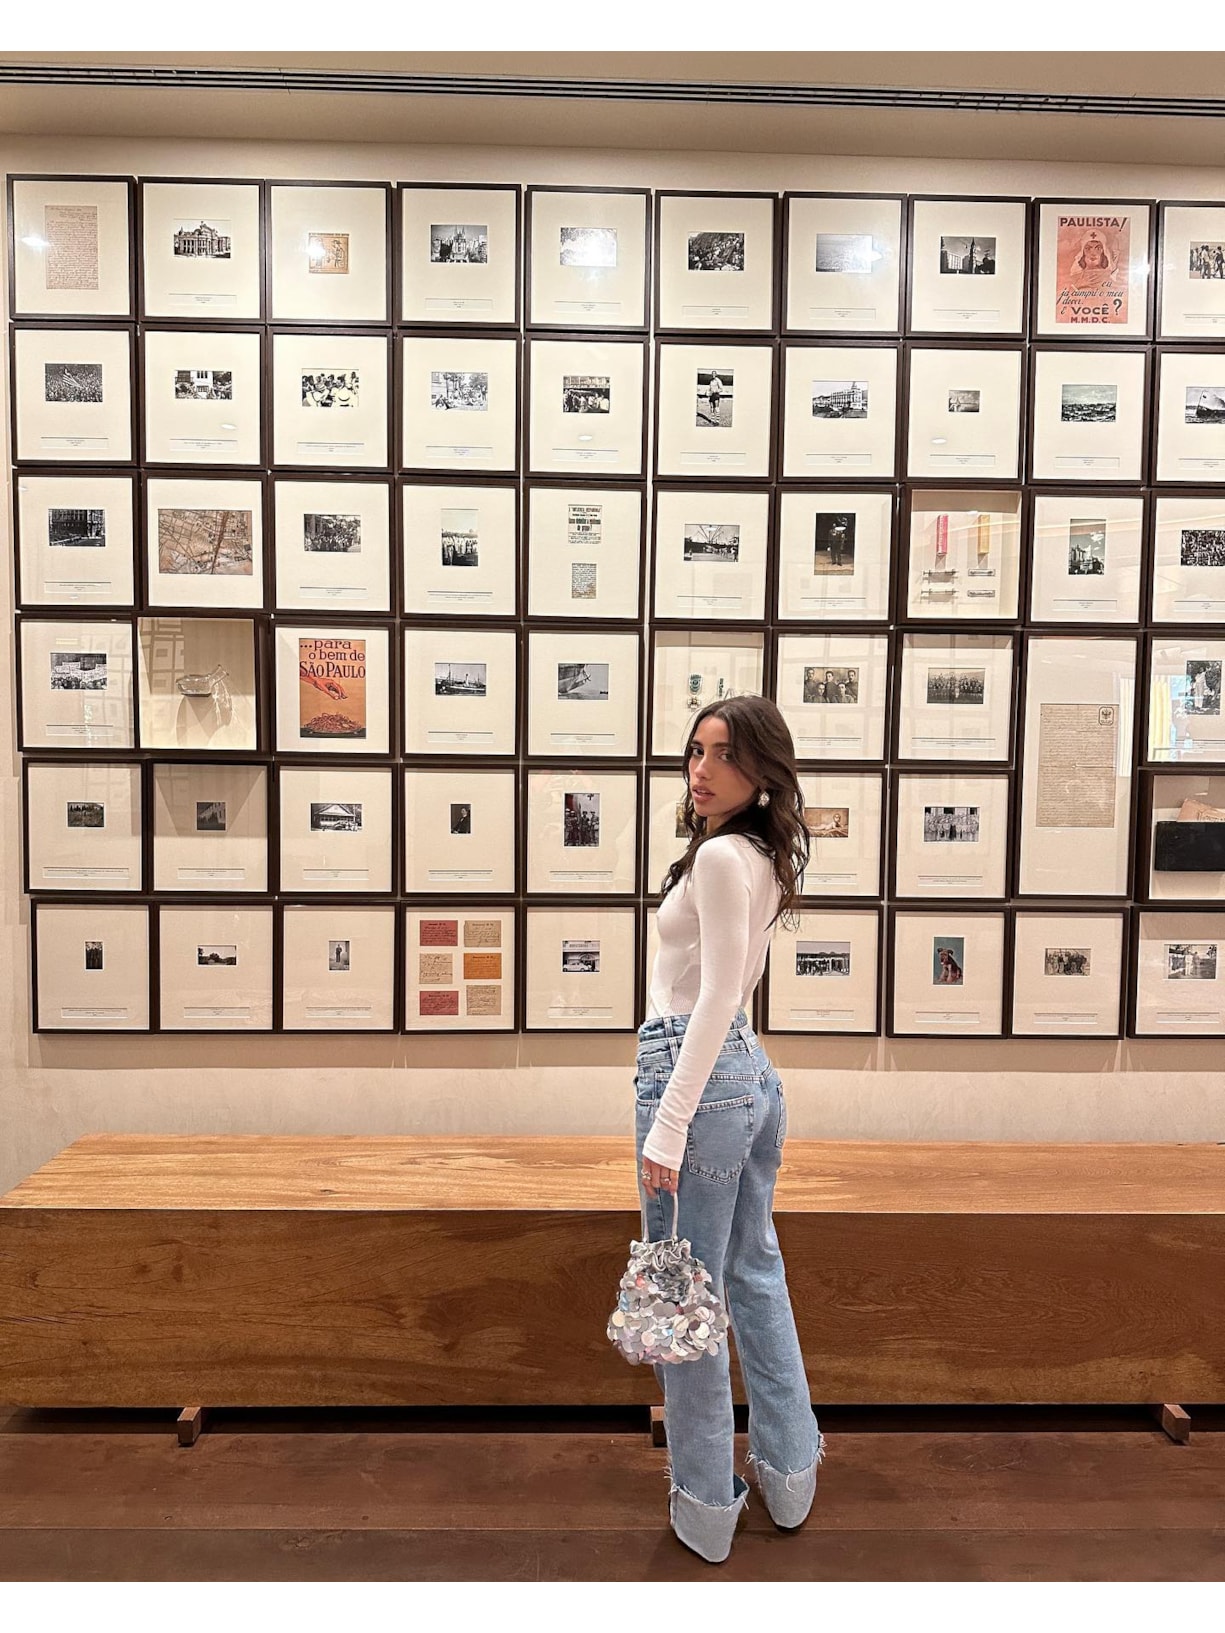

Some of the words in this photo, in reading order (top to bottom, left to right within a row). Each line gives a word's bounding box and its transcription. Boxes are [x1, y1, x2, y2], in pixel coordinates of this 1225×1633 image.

[1060, 218, 1127, 232] PAULISTA!
[308, 652, 317, 660] o
[319, 649, 347, 660] bem
[349, 650, 366, 661] de
[299, 661, 325, 677] SÃO
[326, 661, 366, 678] PAULO
